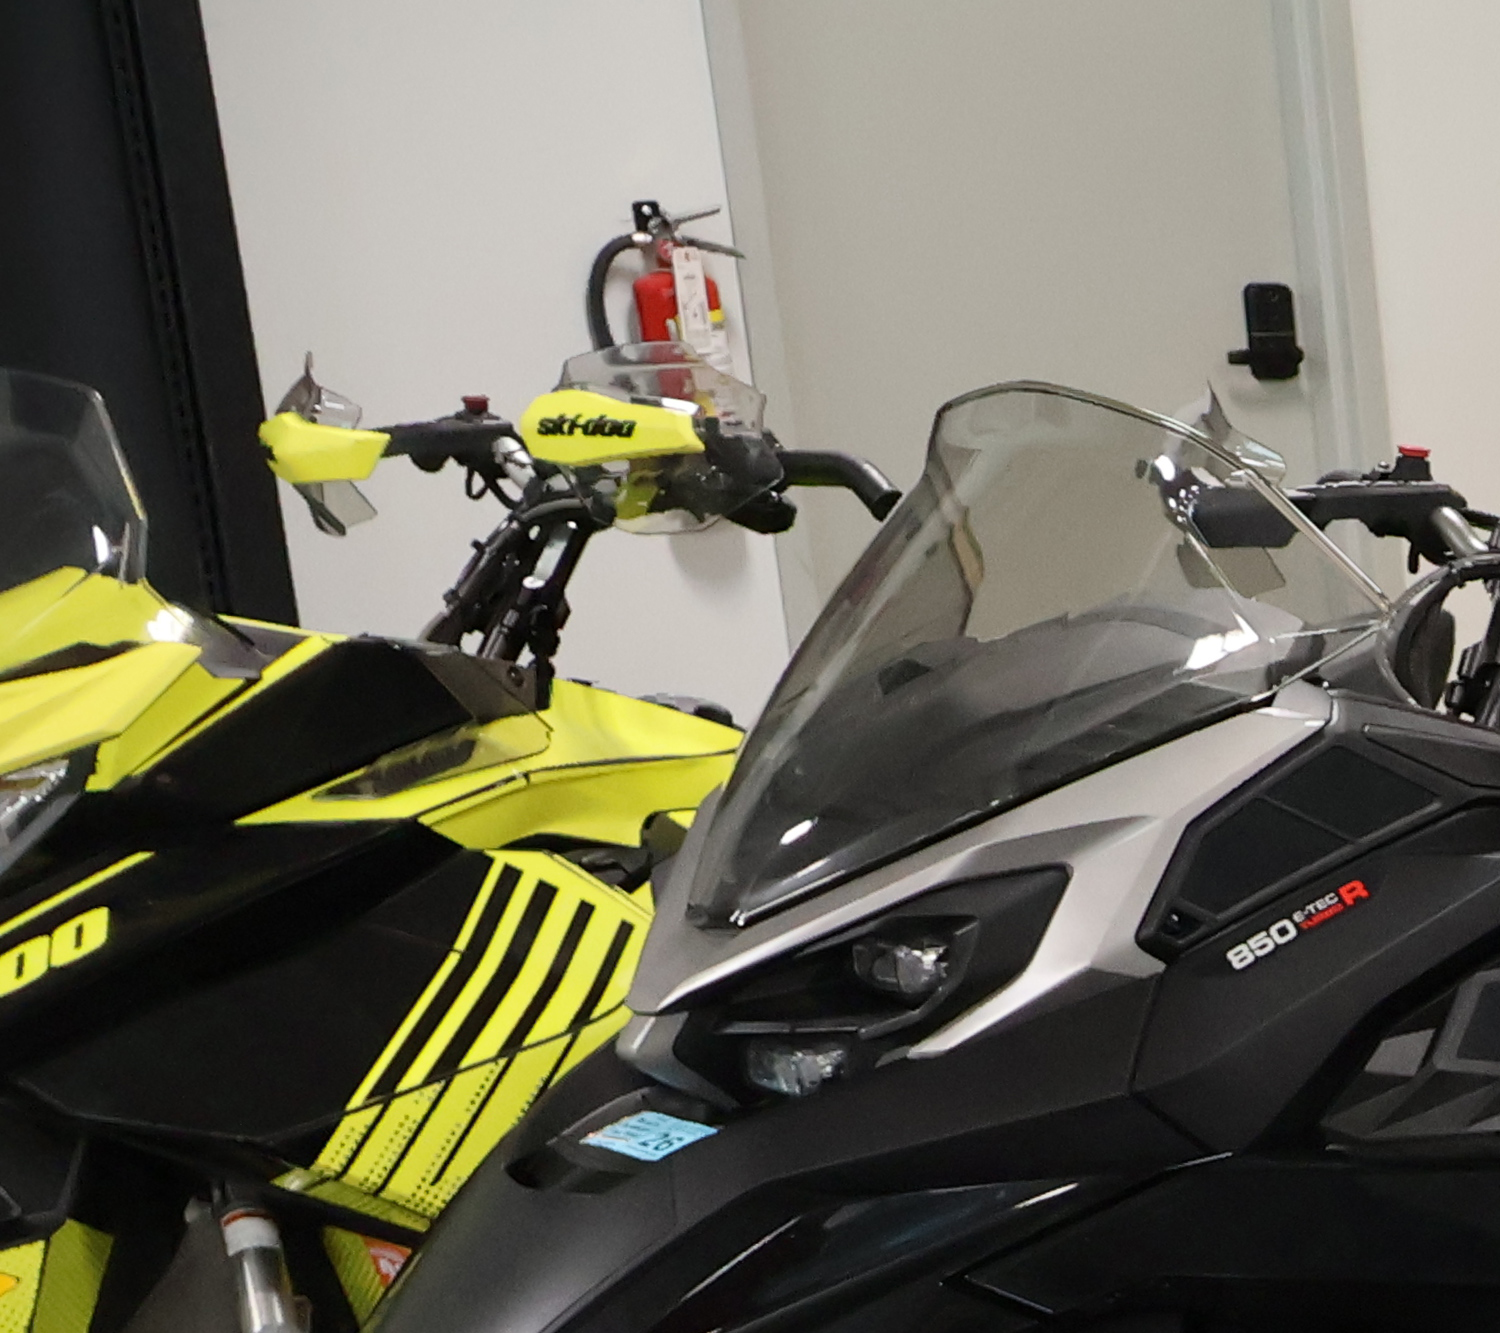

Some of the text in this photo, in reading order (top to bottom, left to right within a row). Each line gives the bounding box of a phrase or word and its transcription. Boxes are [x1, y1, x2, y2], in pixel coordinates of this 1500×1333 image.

[1338, 880, 1371, 906] R
[1226, 892, 1339, 971] 850 E-TEC
